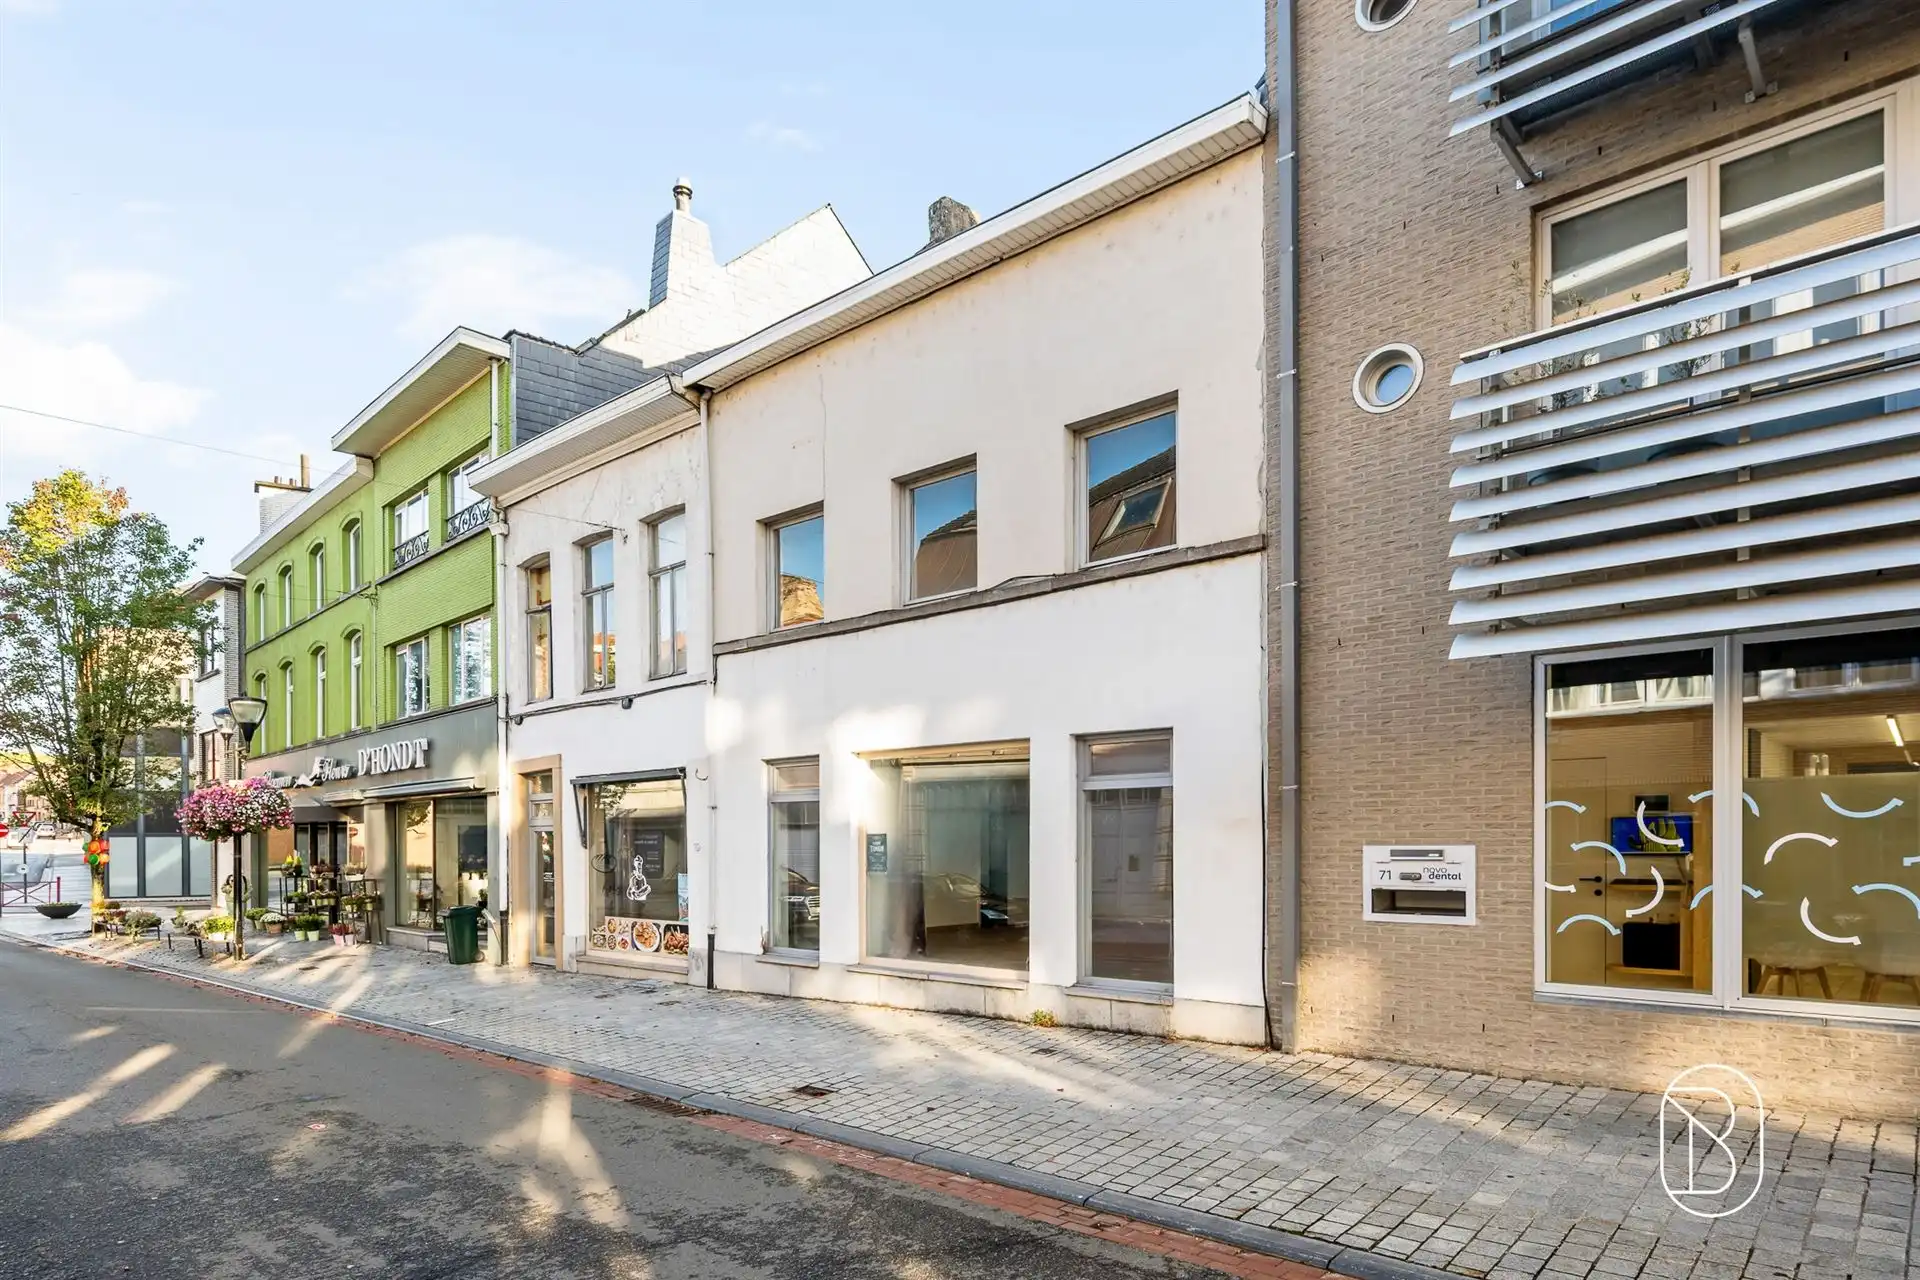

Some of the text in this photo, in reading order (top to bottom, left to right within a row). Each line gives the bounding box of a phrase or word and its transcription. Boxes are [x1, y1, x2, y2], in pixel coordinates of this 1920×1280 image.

[357, 737, 428, 776] D'HONDT
[1379, 869, 1392, 880] 71
[1428, 872, 1462, 881] dental
